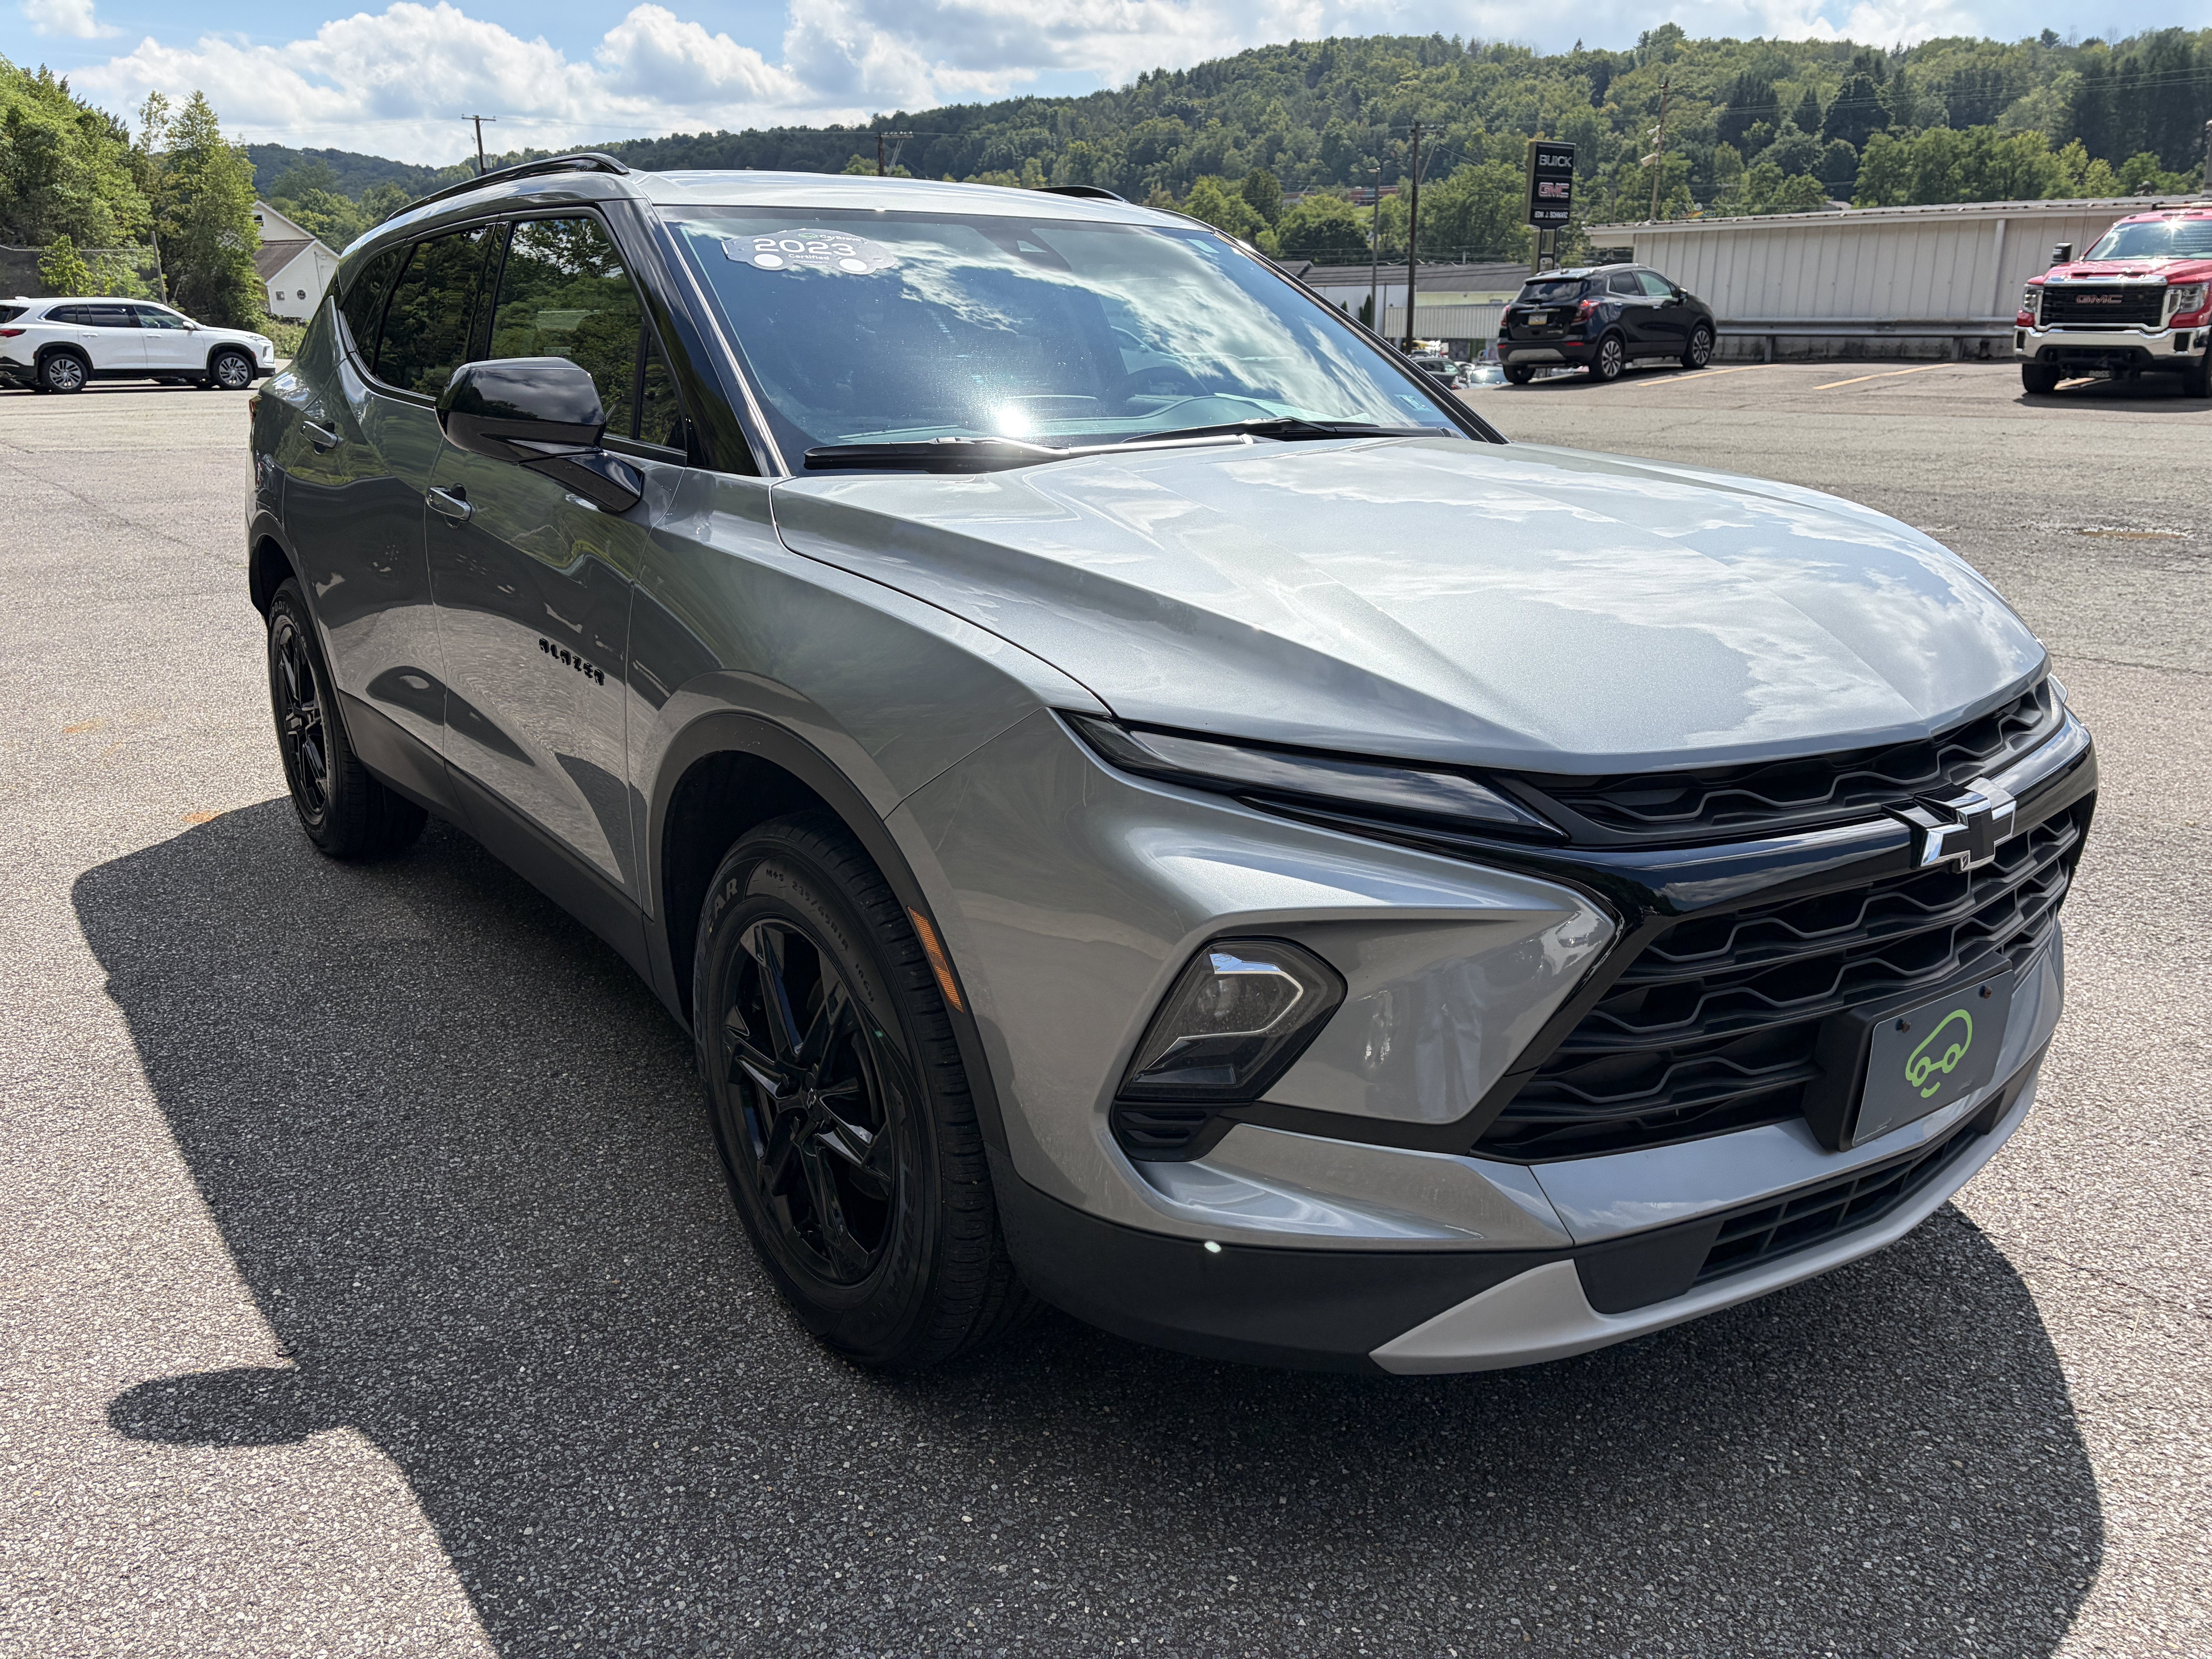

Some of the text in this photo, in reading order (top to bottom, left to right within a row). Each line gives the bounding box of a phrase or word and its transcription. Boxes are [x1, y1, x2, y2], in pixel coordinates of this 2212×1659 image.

[1539, 155, 1572, 167] BUICK
[1539, 182, 1570, 198] GMC
[753, 238, 857, 256] 2023
[2076, 294, 2123, 304] GMC
[539, 638, 605, 686] BLAZER
[871, 1080, 915, 1321] ASSURA
